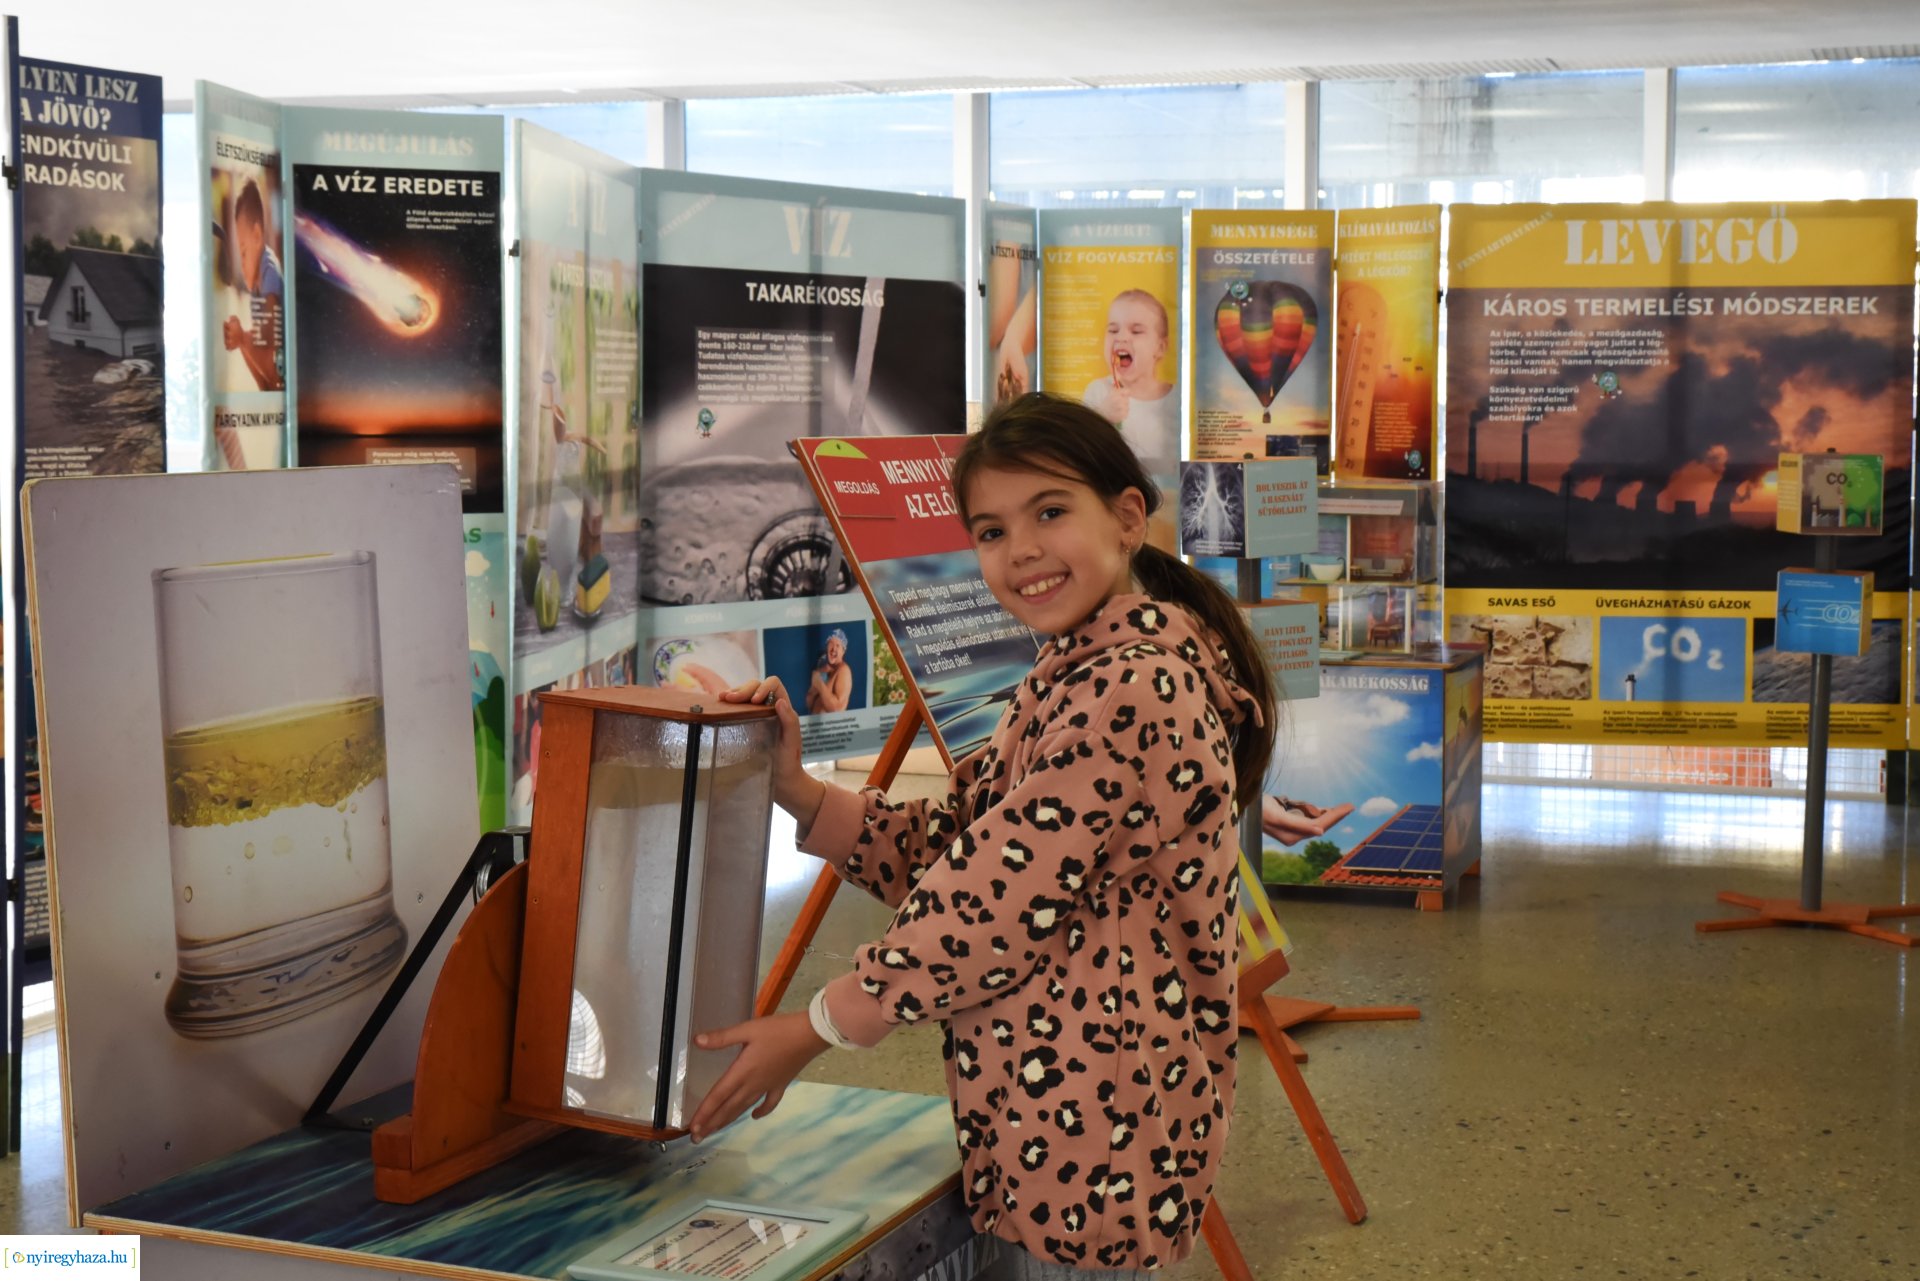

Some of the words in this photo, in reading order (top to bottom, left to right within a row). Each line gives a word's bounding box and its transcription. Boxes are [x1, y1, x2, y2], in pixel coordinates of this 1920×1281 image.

[20, 65, 77, 97] LYEN
[85, 74, 138, 104] LESZ
[38, 96, 112, 131] JÖVŐ?
[20, 133, 132, 165] NDKÍVÜLI
[322, 128, 474, 157] MEGÚJULÁS
[24, 163, 126, 192] RADÁSOK
[312, 173, 329, 191] A
[335, 170, 377, 193] VÍZ
[384, 176, 484, 196] EREDETE
[782, 196, 853, 258] VÍZ
[1210, 221, 1319, 240] MENNYISÉGE
[1564, 204, 1799, 265] LEVEGŐ
[1077, 247, 1175, 264] FOGYASZTÁS
[1213, 249, 1316, 264] ÖSSZETÉTELE
[746, 280, 885, 307] TAKARÉKOSSÁG
[1483, 293, 1568, 317] KÁROS
[1575, 292, 1714, 316] TERMELÉSI
[1723, 291, 1879, 316] MÓDSZEREK
[1489, 330, 1501, 338] Az
[1503, 330, 1524, 339] ipar,
[1534, 330, 1586, 339] közlekedés,
[1596, 329, 1665, 340] mezőgazdaság,
[1489, 339, 1522, 347] sokféle
[1524, 339, 1571, 349] szennyező
[1572, 340, 1610, 349] anyagot
[1611, 340, 1637, 348] juttat
[1489, 348, 1519, 357] körbe.
[1521, 348, 1548, 357] Ennek
[1550, 348, 1590, 357] nemcsak
[1591, 349, 1670, 359] egészségkárosító
[1489, 357, 1522, 366] hatásai
[1525, 357, 1560, 367] vannak,
[1594, 358, 1662, 368] megváltoztatja
[1489, 367, 1509, 375] Föld
[1511, 367, 1548, 377] klímáját
[1549, 367, 1561, 375] is.
[1489, 385, 1527, 395] Szükség
[1546, 385, 1580, 395] szigorú
[1489, 394, 1569, 404] környezetvédelmi
[1488, 404, 1542, 414] szabályokra
[1544, 404, 1556, 413] és
[1556, 404, 1579, 413] azok
[1488, 413, 1544, 422] betartására!
[880, 459, 941, 485] MENNYI
[834, 480, 881, 496] MEGOLDÁS
[905, 494, 930, 518] AZ
[924, 485, 958, 516] ELŐ
[888, 588, 918, 605] Tippeld
[950, 579, 973, 594] mennyi
[973, 578, 983, 590] víz
[1488, 597, 1528, 608] SAVAS
[1532, 595, 1556, 608] ESŐ
[1595, 596, 1705, 610] ÜVEGHÁZHATÁSÚ
[1708, 597, 1752, 610] GÁZOK
[898, 611, 906, 621] a
[904, 605, 937, 621] különféle
[936, 597, 977, 615] élelmiszerek
[906, 623, 927, 639] Rakd
[931, 617, 964, 635] megfelelő
[963, 614, 985, 629] helyre
[984, 612, 993, 624] az
[915, 643, 924, 656] A
[922, 638, 957, 656] megoldás
[956, 630, 993, 647] ellenőrzése
[924, 663, 932, 675] a
[930, 656, 957, 673] tartóba
[955, 652, 973, 669] őket!
